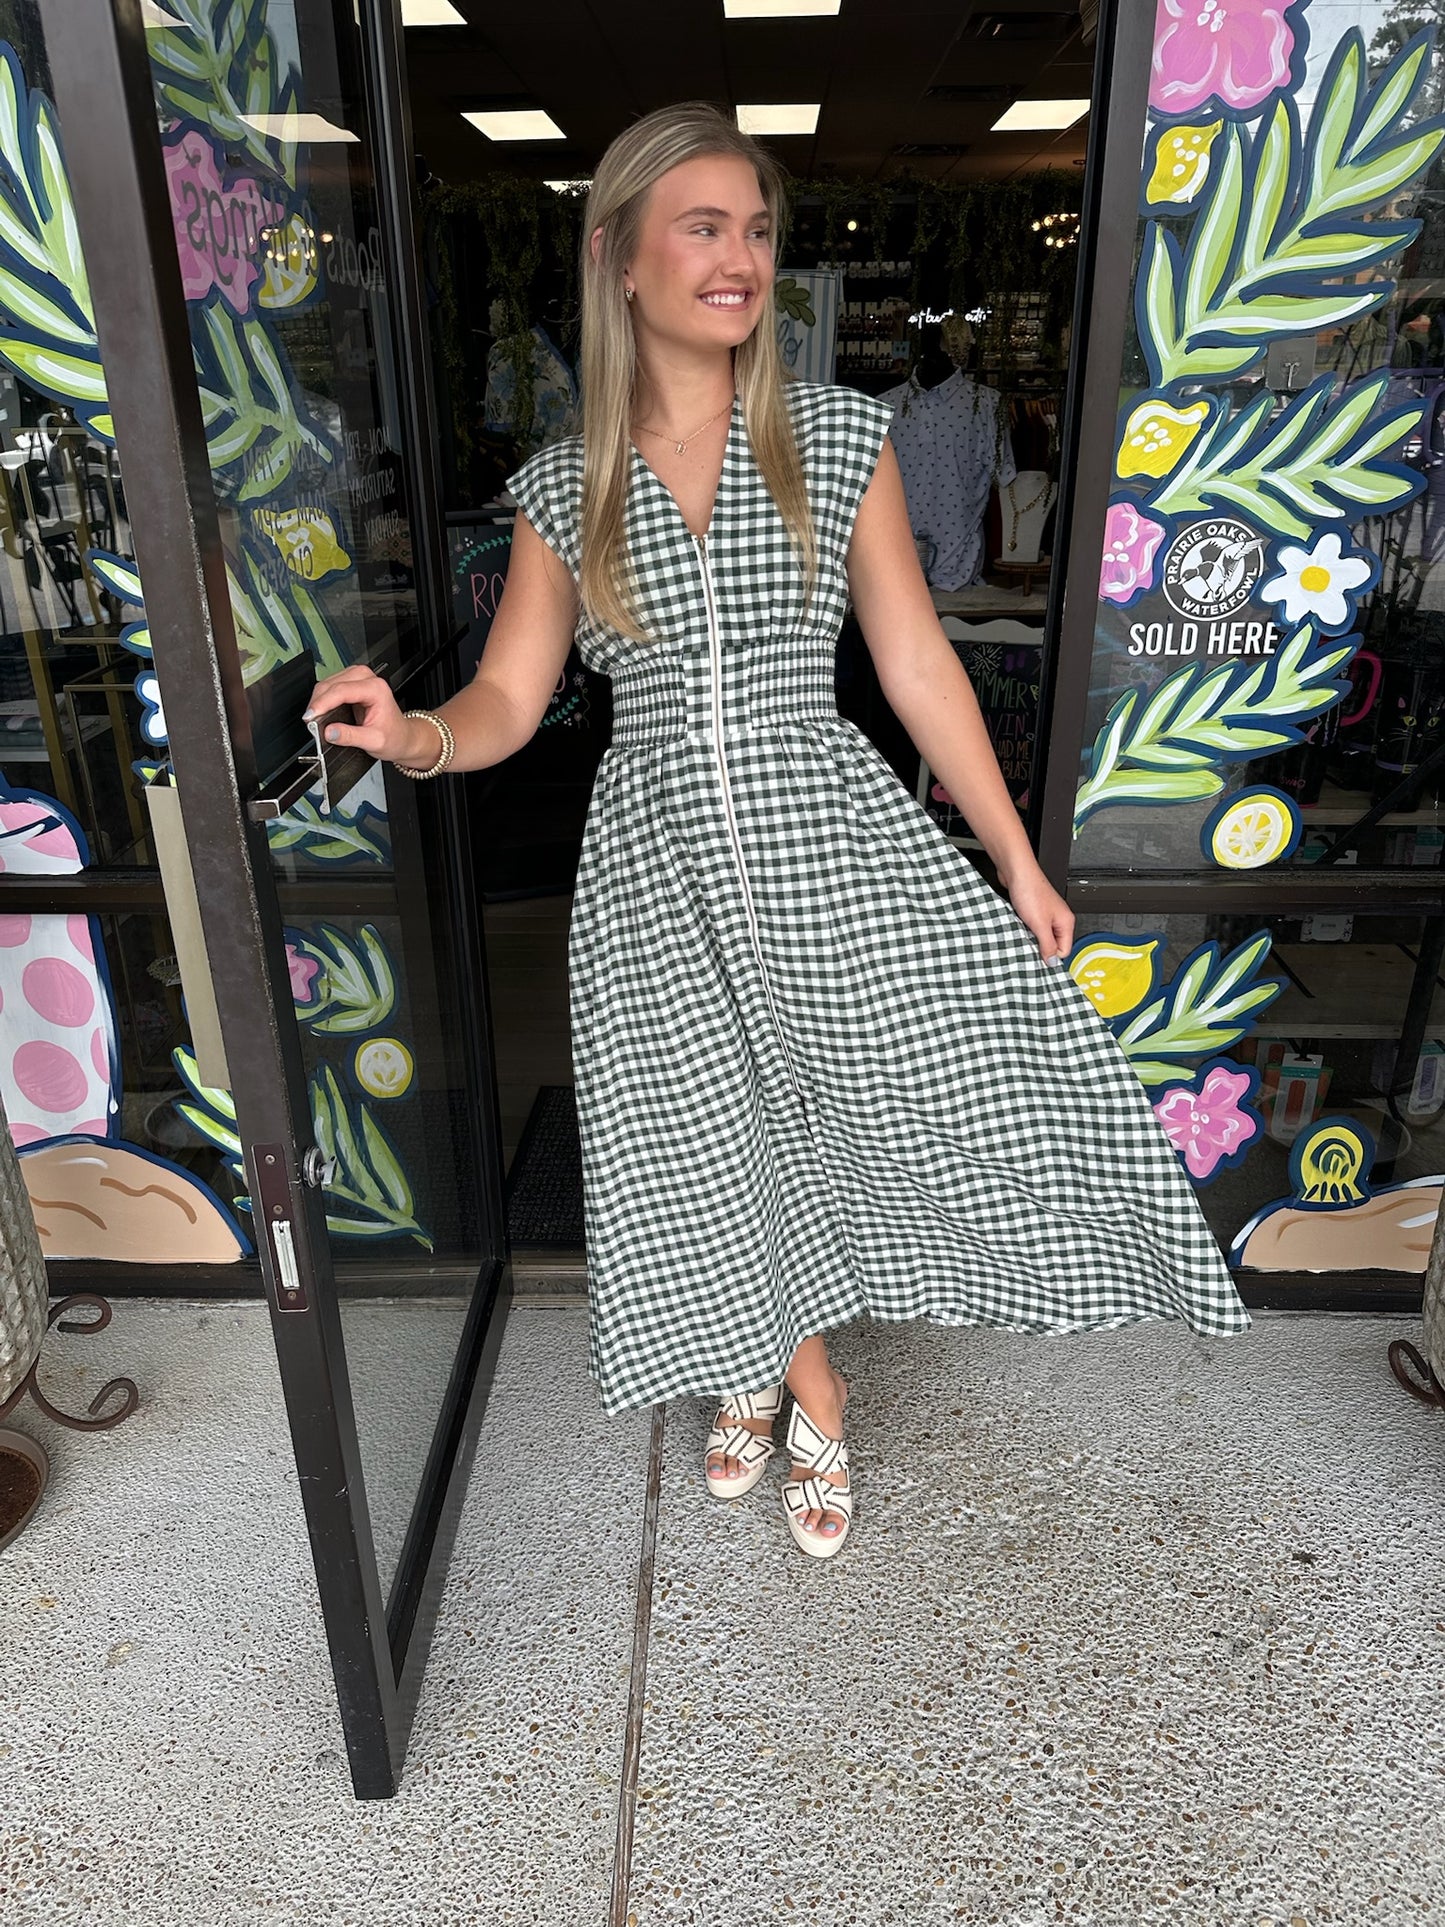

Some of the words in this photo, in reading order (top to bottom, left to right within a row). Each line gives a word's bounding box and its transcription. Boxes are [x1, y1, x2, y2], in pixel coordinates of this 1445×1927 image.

[1166, 527, 1203, 585] PRAIRIE
[1206, 524, 1248, 543] OAKS
[1181, 567, 1259, 616] WATERFOWL
[1128, 622, 1199, 656] SOLD
[1207, 622, 1279, 656] HERE
[976, 669, 1028, 709] MMER
